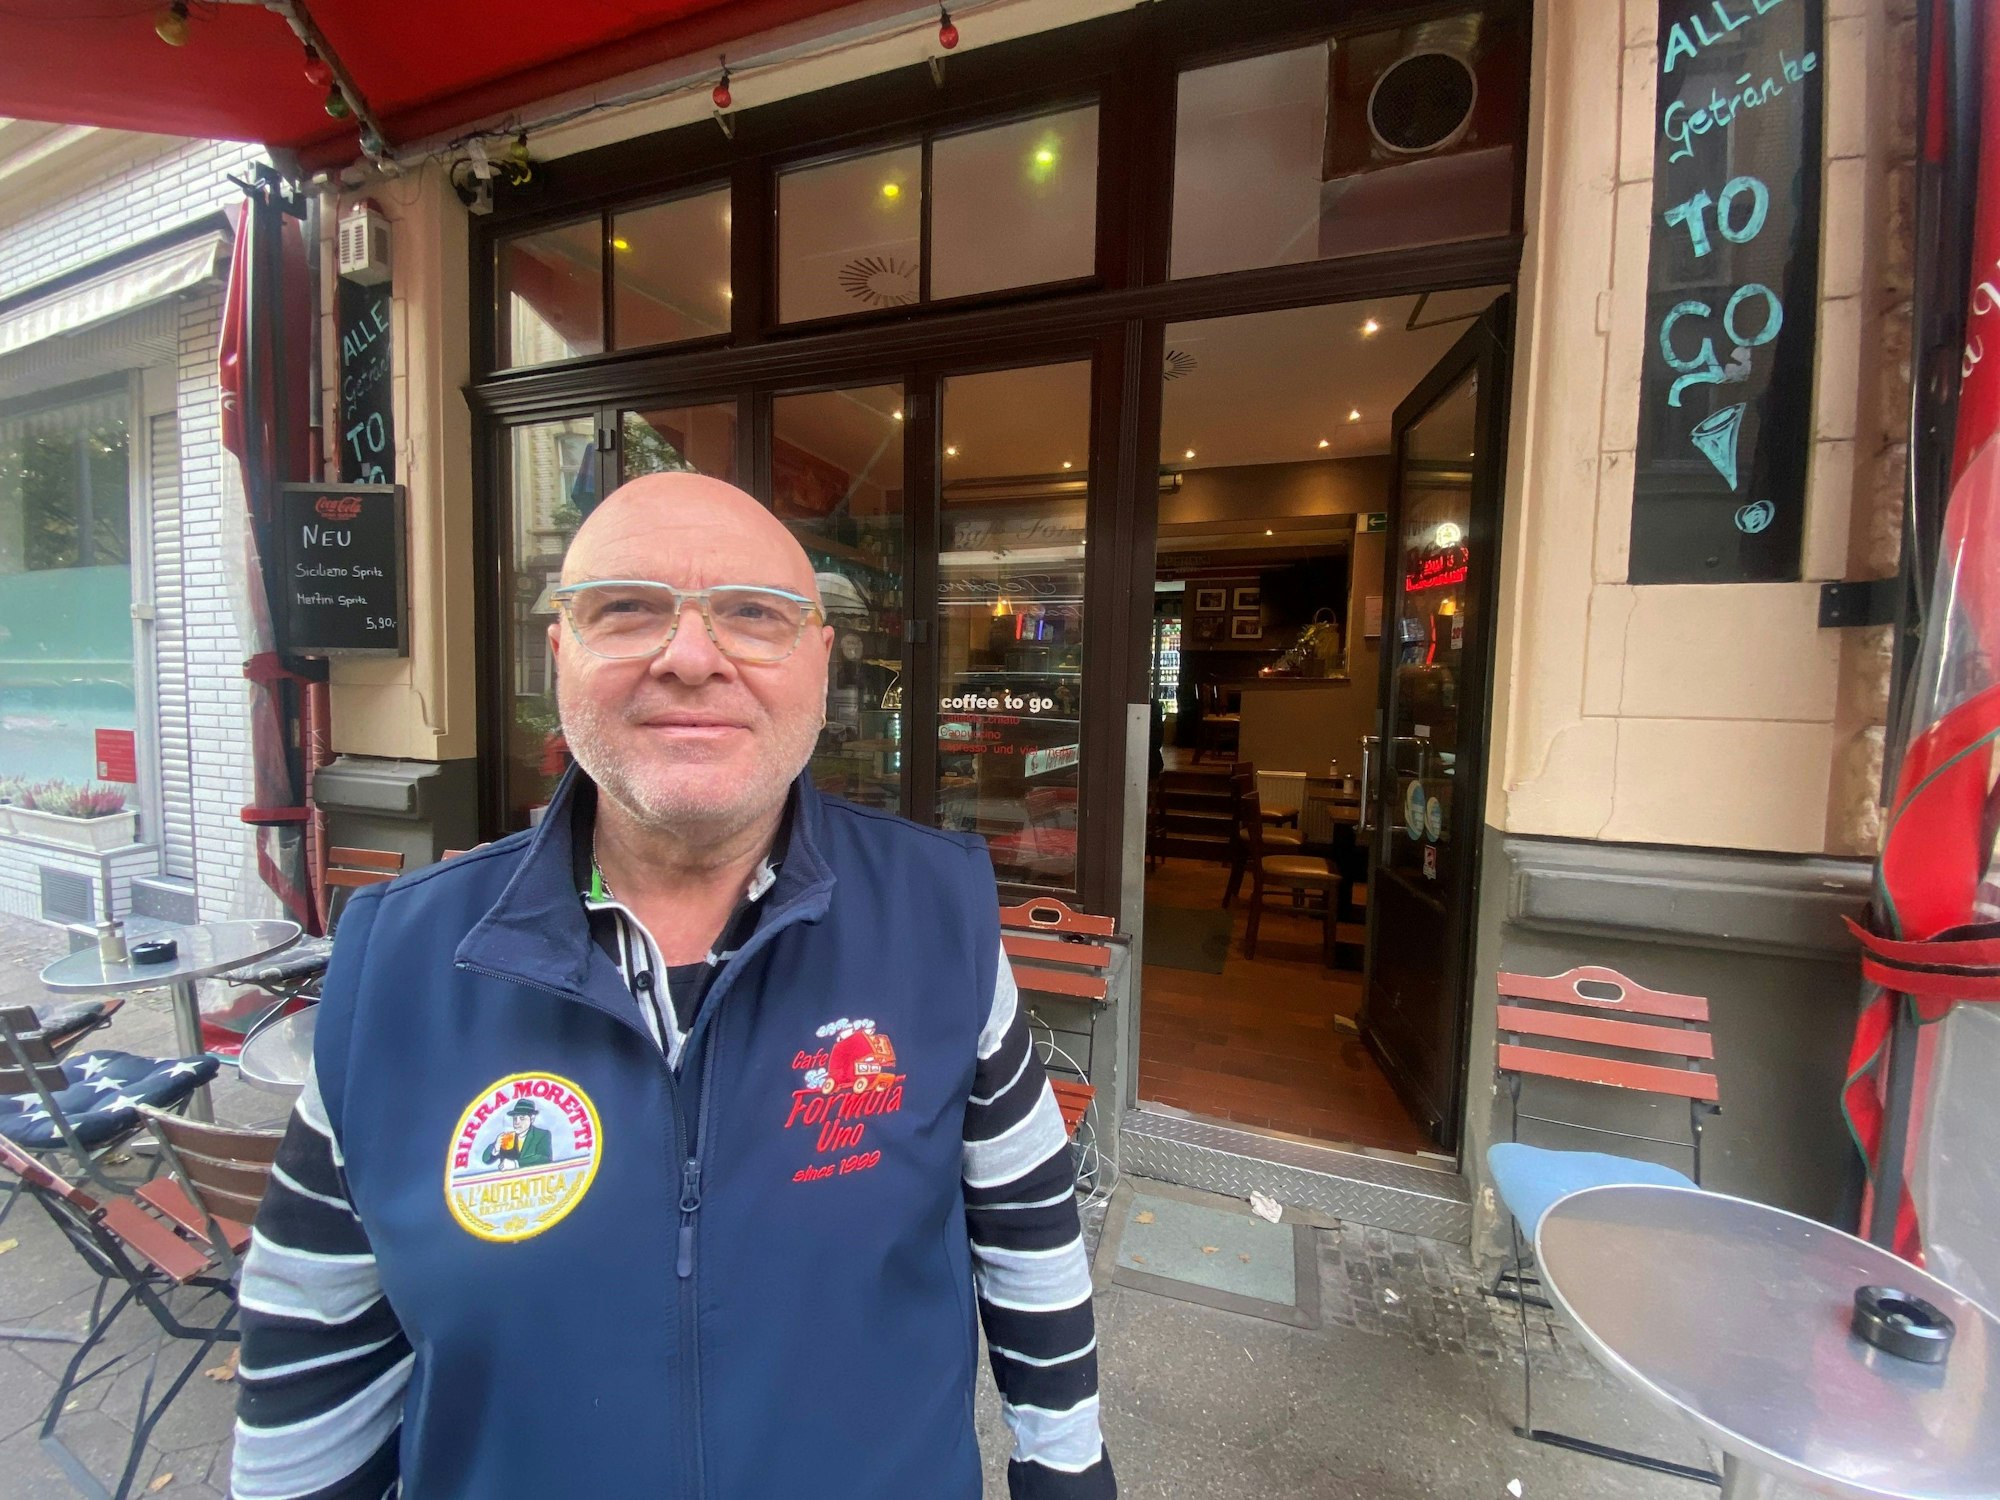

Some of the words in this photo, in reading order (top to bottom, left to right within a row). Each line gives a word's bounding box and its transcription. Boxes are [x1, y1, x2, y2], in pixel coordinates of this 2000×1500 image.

[1663, 176, 1770, 258] TO
[342, 300, 390, 367] ALLE
[1659, 282, 1784, 408] GO
[346, 411, 386, 463] TO
[302, 524, 352, 549] NEU
[295, 562, 348, 578] Siciliano
[352, 565, 384, 580] Spritz
[338, 595, 368, 608] Spritz
[941, 693, 999, 709] coffee
[1004, 693, 1024, 710] to
[1029, 697, 1054, 714] go
[993, 743, 1014, 755] und
[791, 1047, 830, 1071] Cafe
[784, 1075, 905, 1129] Formula
[454, 1089, 511, 1170] BIRRA
[511, 1080, 594, 1152] MORETTI
[815, 1117, 866, 1153] Uno
[791, 1163, 837, 1183] since
[838, 1149, 882, 1176] 1999
[468, 1173, 567, 1208] L'AUTENTICA
